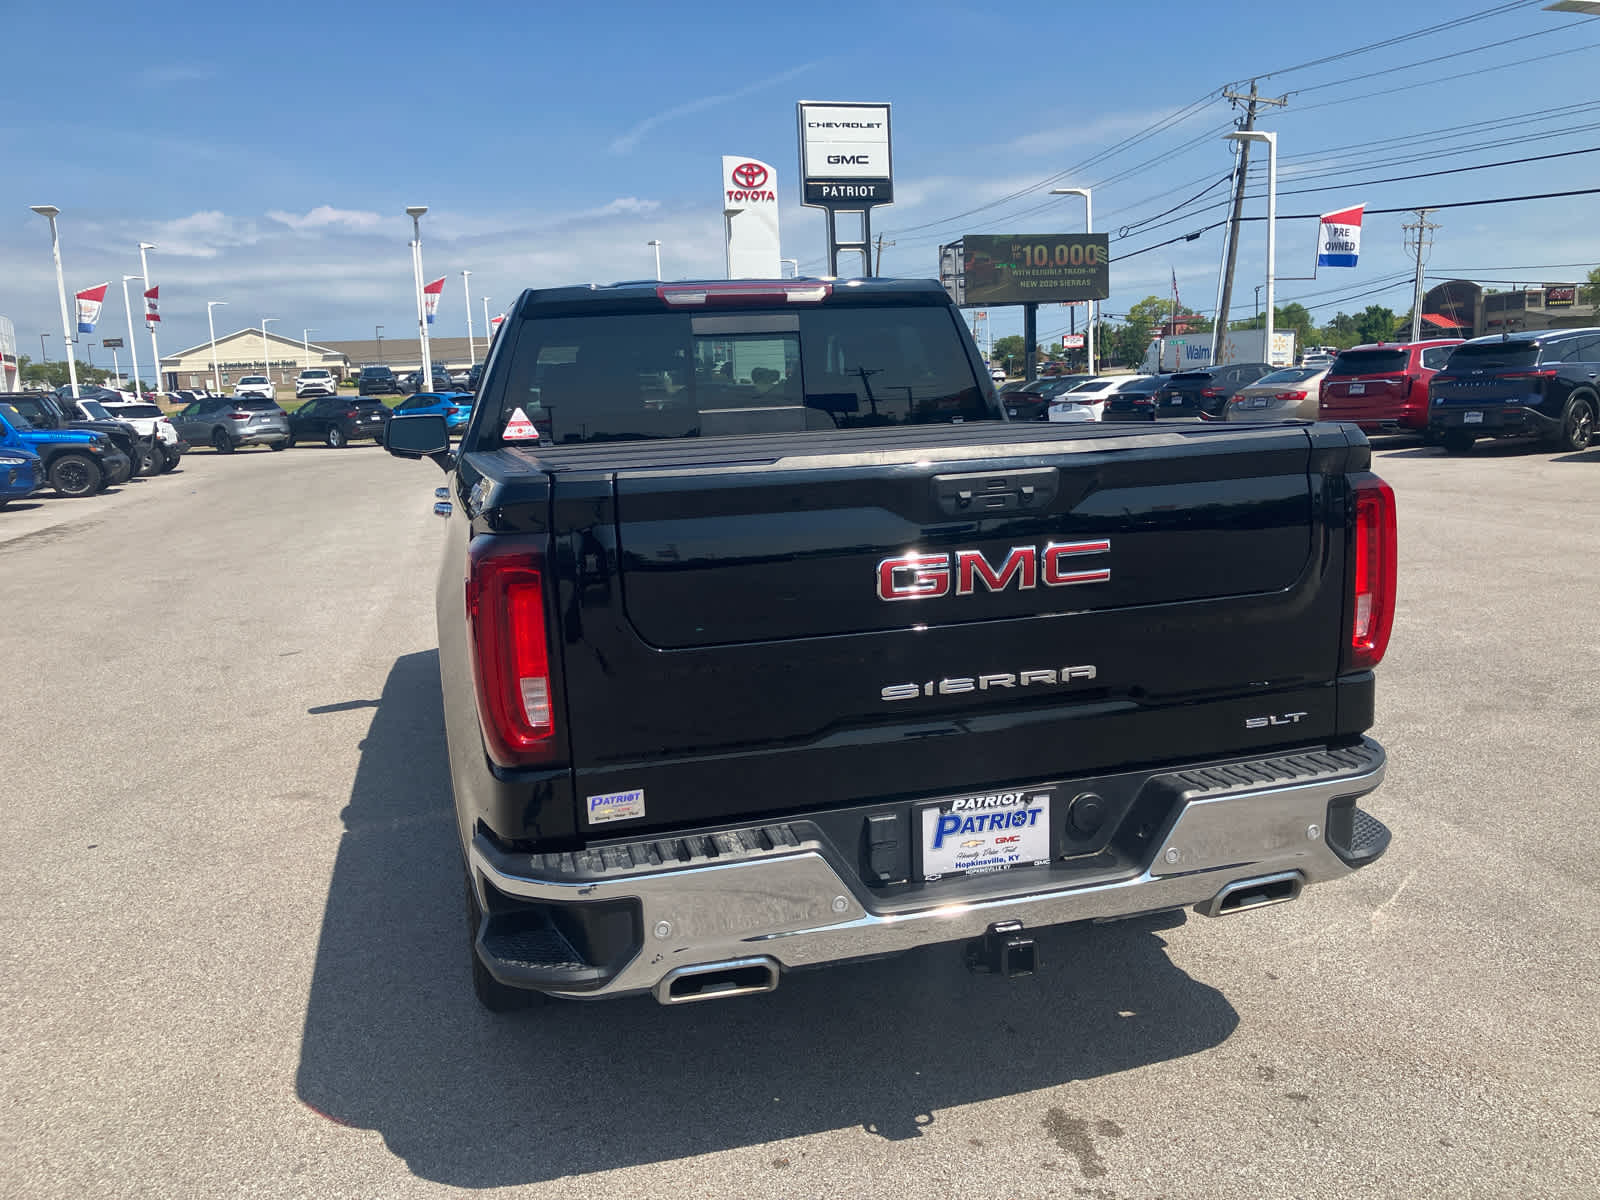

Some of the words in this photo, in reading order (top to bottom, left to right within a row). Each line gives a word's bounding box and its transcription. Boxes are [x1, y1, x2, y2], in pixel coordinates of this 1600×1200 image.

[827, 155, 869, 165] GMC
[726, 190, 775, 202] TOYOTA
[822, 186, 875, 197] PATRIOT
[1333, 227, 1351, 237] PRE
[1324, 241, 1356, 251] OWNED
[876, 538, 1111, 601] GMC
[880, 664, 1097, 701] SIERRA
[1245, 711, 1308, 729] SLT
[591, 792, 640, 811] PATRIOT
[952, 793, 1024, 812] PATRIOT
[932, 809, 1041, 849] PATRIOT
[995, 835, 1021, 844] GMC
[955, 858, 1006, 869] Hopkinsville,
[1008, 854, 1020, 862] KY
